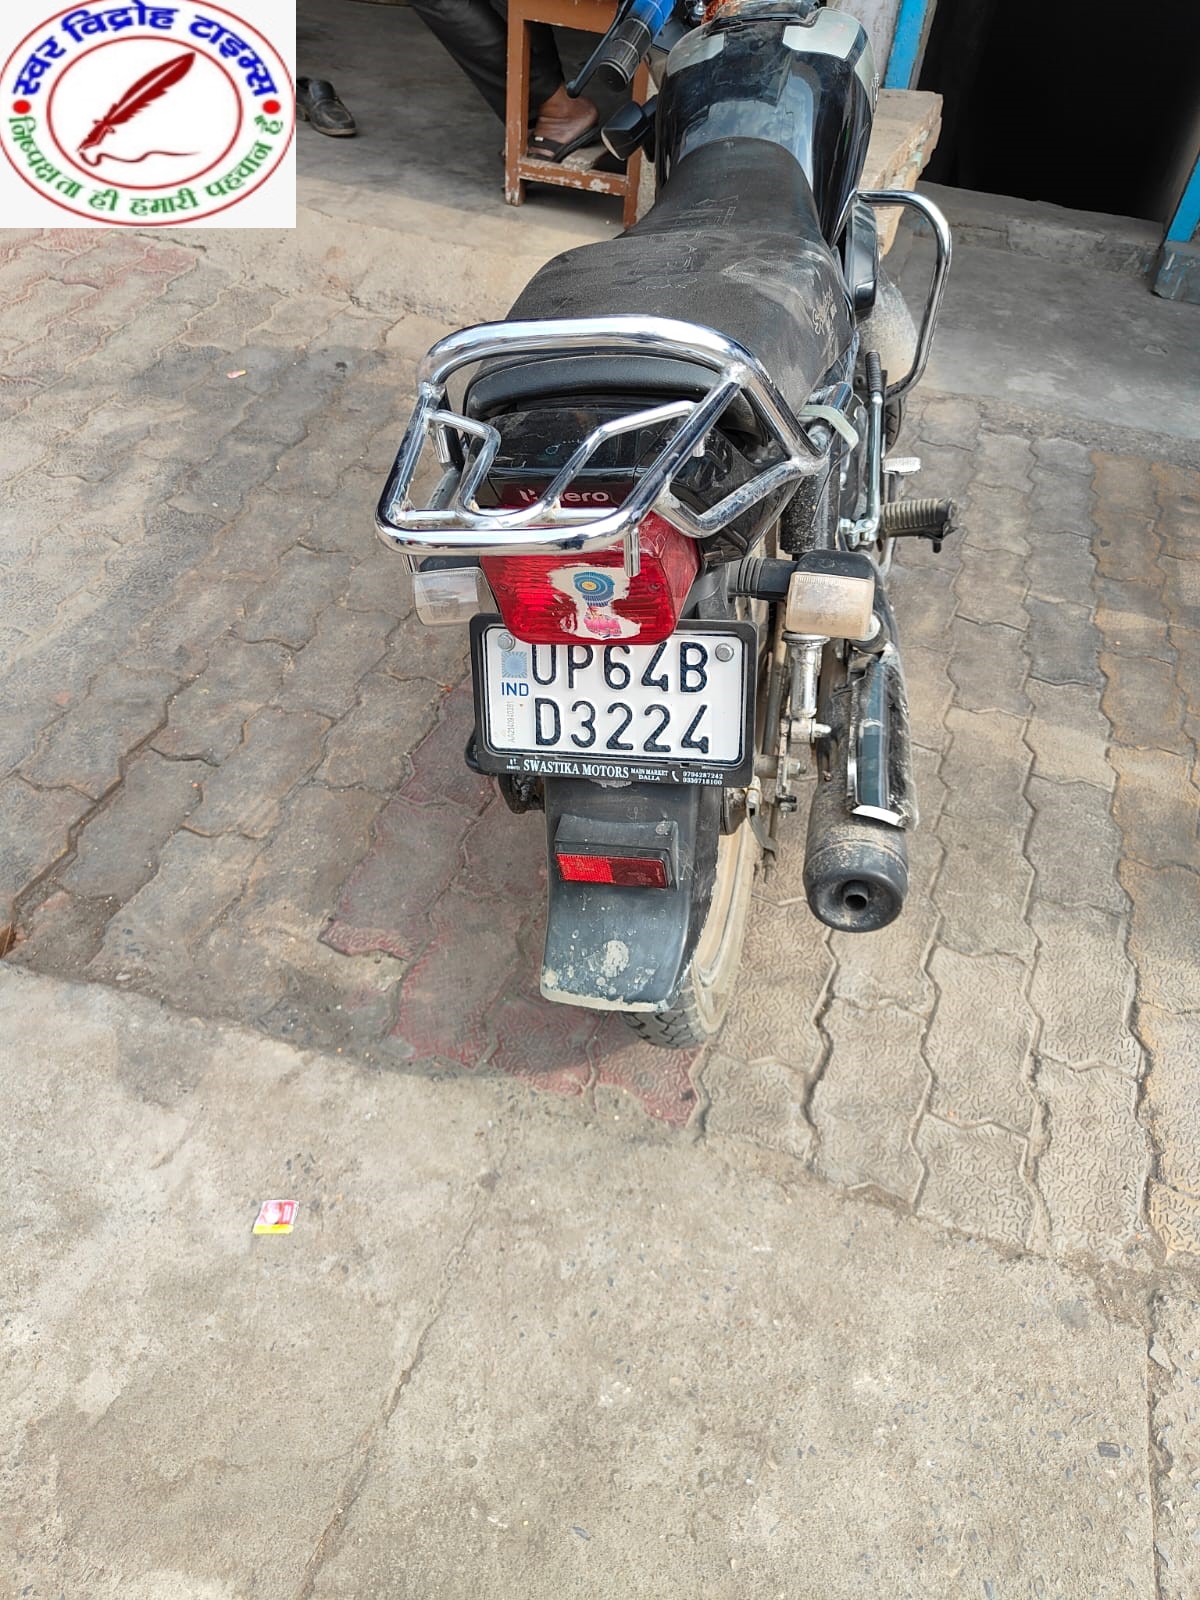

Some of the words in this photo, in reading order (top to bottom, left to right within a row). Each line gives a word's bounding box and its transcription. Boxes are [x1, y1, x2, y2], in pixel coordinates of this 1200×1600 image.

[531, 641, 709, 693] UP64B
[501, 682, 529, 697] IND
[535, 697, 709, 754] D3224
[523, 758, 580, 775] SWASTIKA
[582, 763, 629, 779] MOTORS
[645, 768, 669, 777] MARKET
